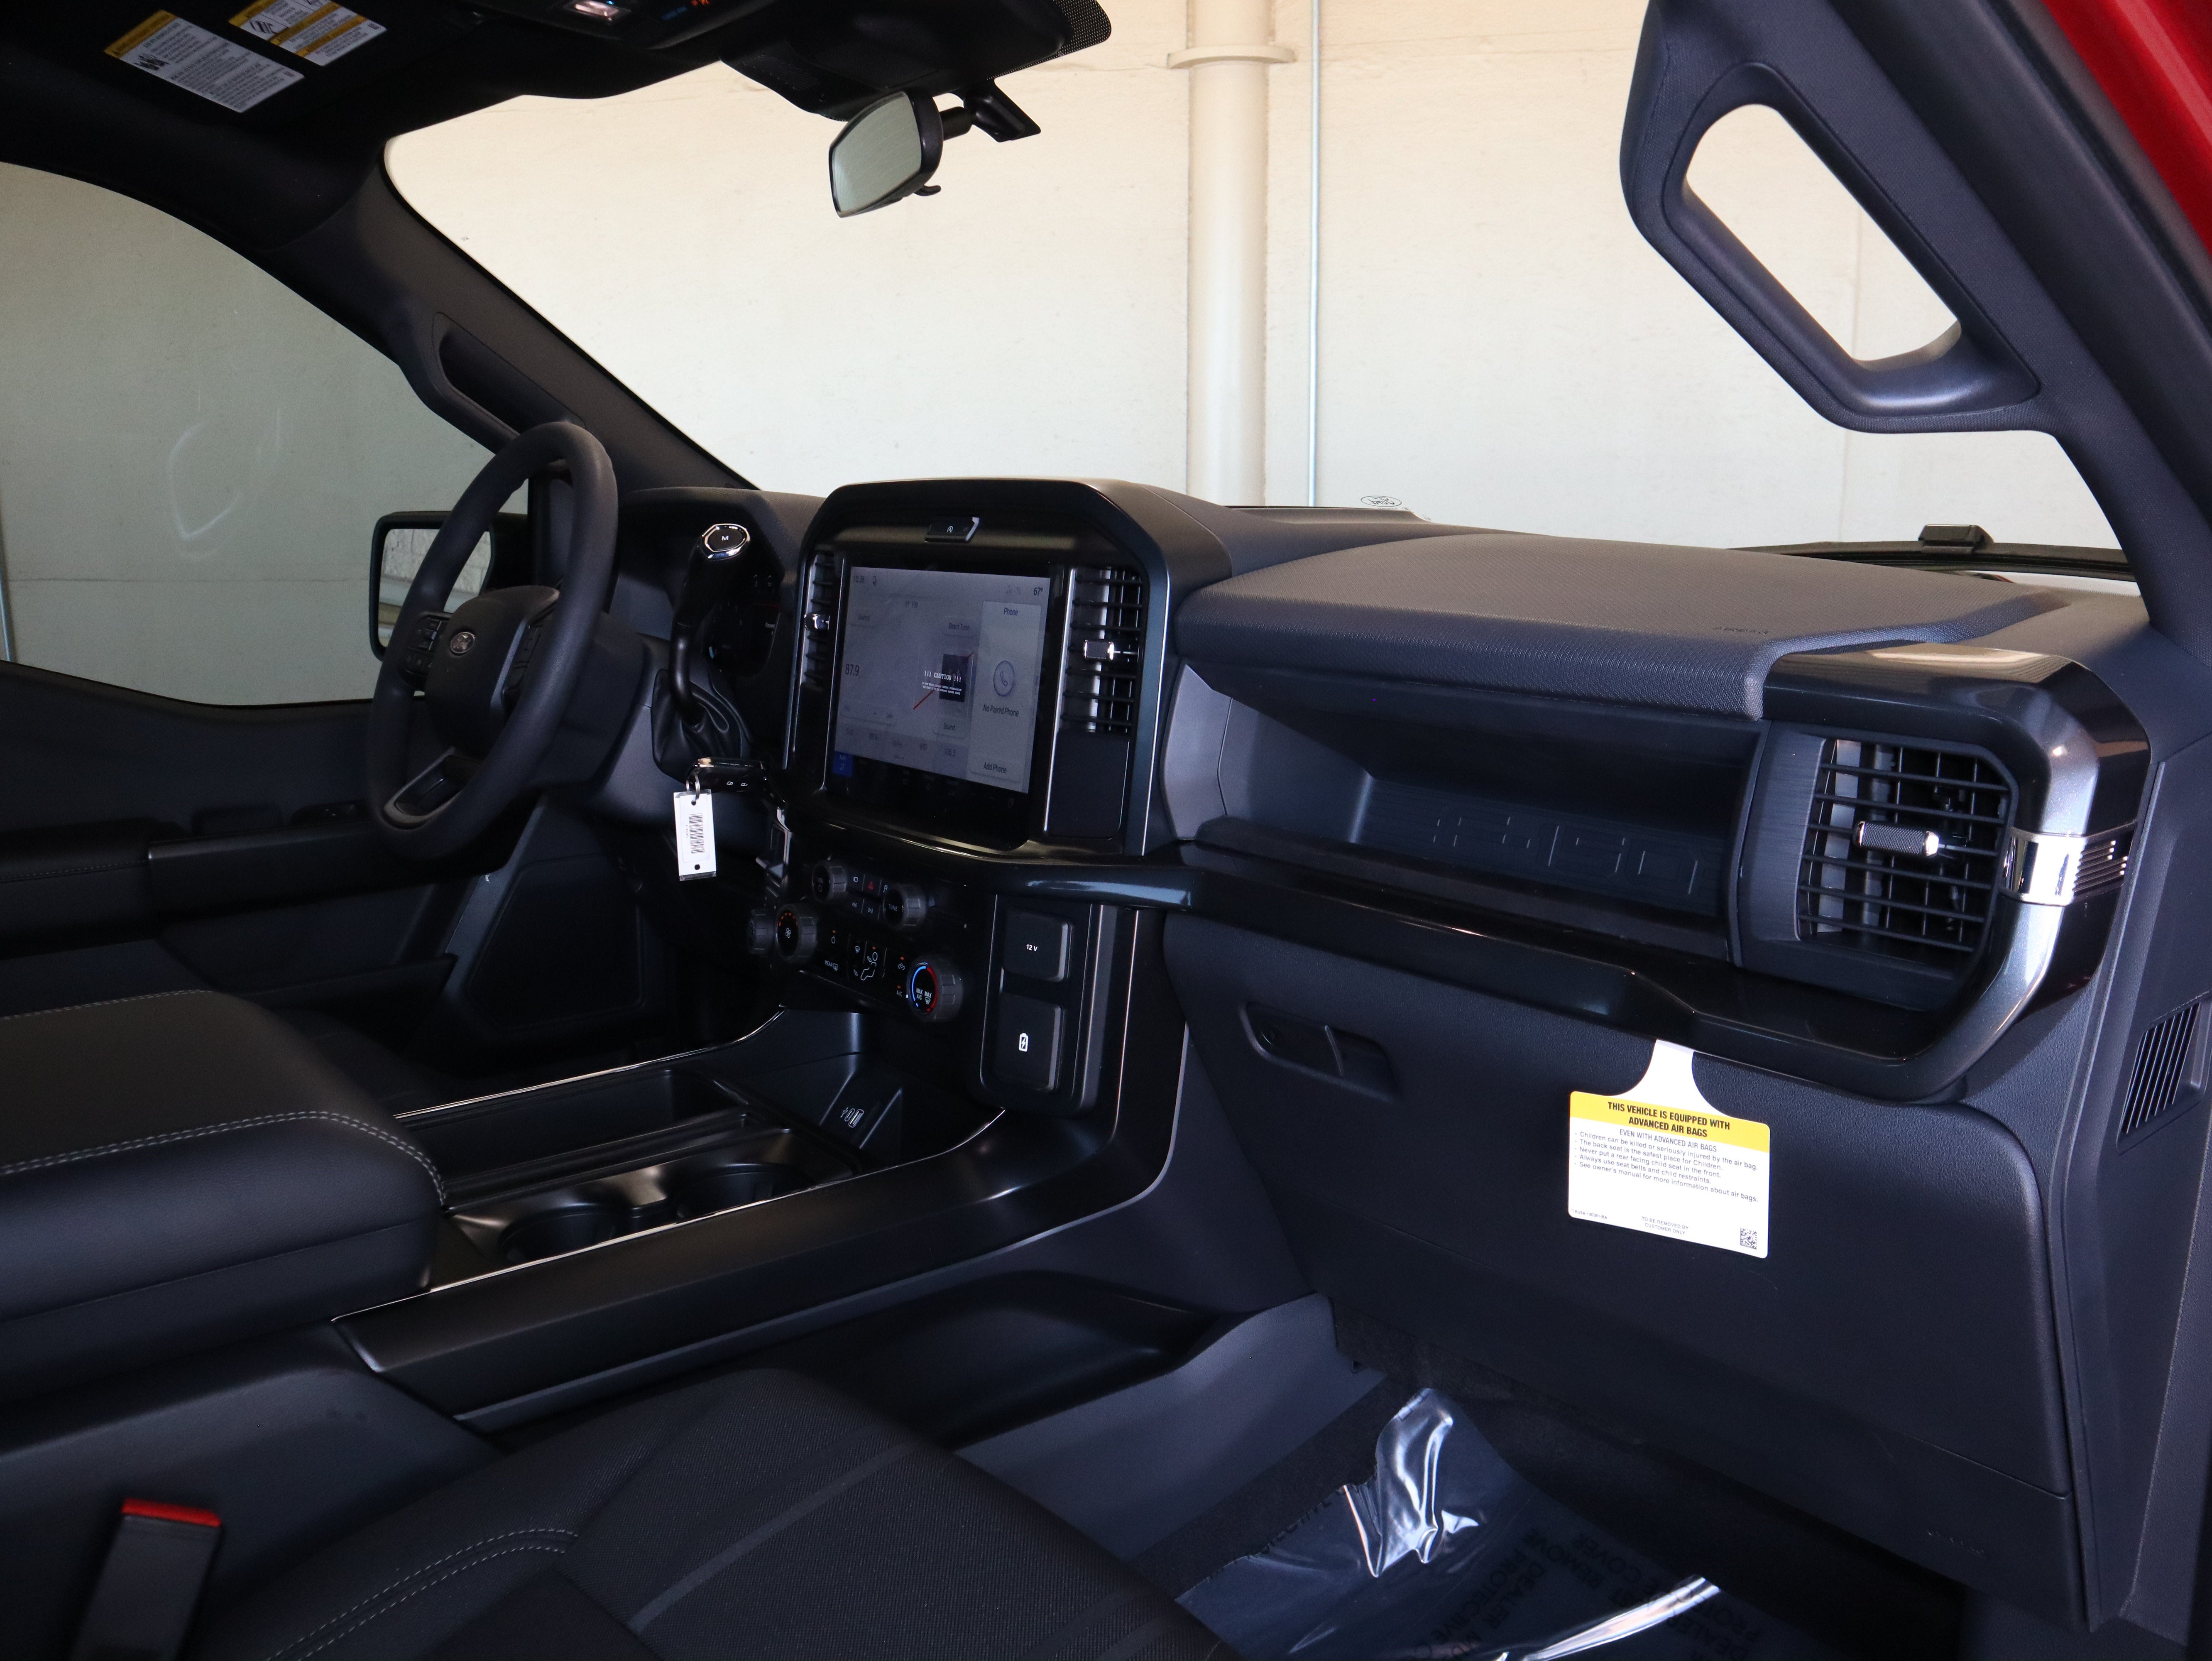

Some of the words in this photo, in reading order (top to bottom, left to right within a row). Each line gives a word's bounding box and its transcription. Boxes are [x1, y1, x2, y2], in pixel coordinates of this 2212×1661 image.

[1003, 608, 1018, 616] Phone
[845, 664, 859, 676] 87.9
[934, 672, 952, 681] CAUTION
[983, 704, 990, 712] No
[990, 705, 1005, 715] Paired
[1005, 708, 1019, 718] Phone
[943, 723, 956, 731] Sound
[983, 762, 992, 771] Add
[992, 764, 1007, 774] Phone
[1607, 1102, 1625, 1112] THIS
[1627, 1105, 1657, 1117] VEHICLE
[1659, 1110, 1667, 1119] IS
[1669, 1112, 1707, 1126] EQUIPPED
[1709, 1119, 1730, 1130] WITH
[1628, 1117, 1669, 1130] ADVANCED
[1671, 1124, 1684, 1133] AIR
[1686, 1127, 1708, 1137] BAGS
[1580, 1131, 1605, 1140] Children
[1657, 1146, 1686, 1156] seriously
[1688, 1151, 1710, 1161] injured
[1619, 1129, 1635, 1137] EVEN
[1654, 1135, 1686, 1147] ADVANCED
[1700, 1143, 1717, 1152] BAGS
[1579, 1154, 1601, 1163] Always
[1630, 1155, 1649, 1166] facing
[1663, 1155, 1680, 1164] place
[1671, 1180, 1708, 1191] information
[1644, 1222, 1671, 1231] CUSTOMER
[1657, 1220, 1681, 1228] REMOVED
